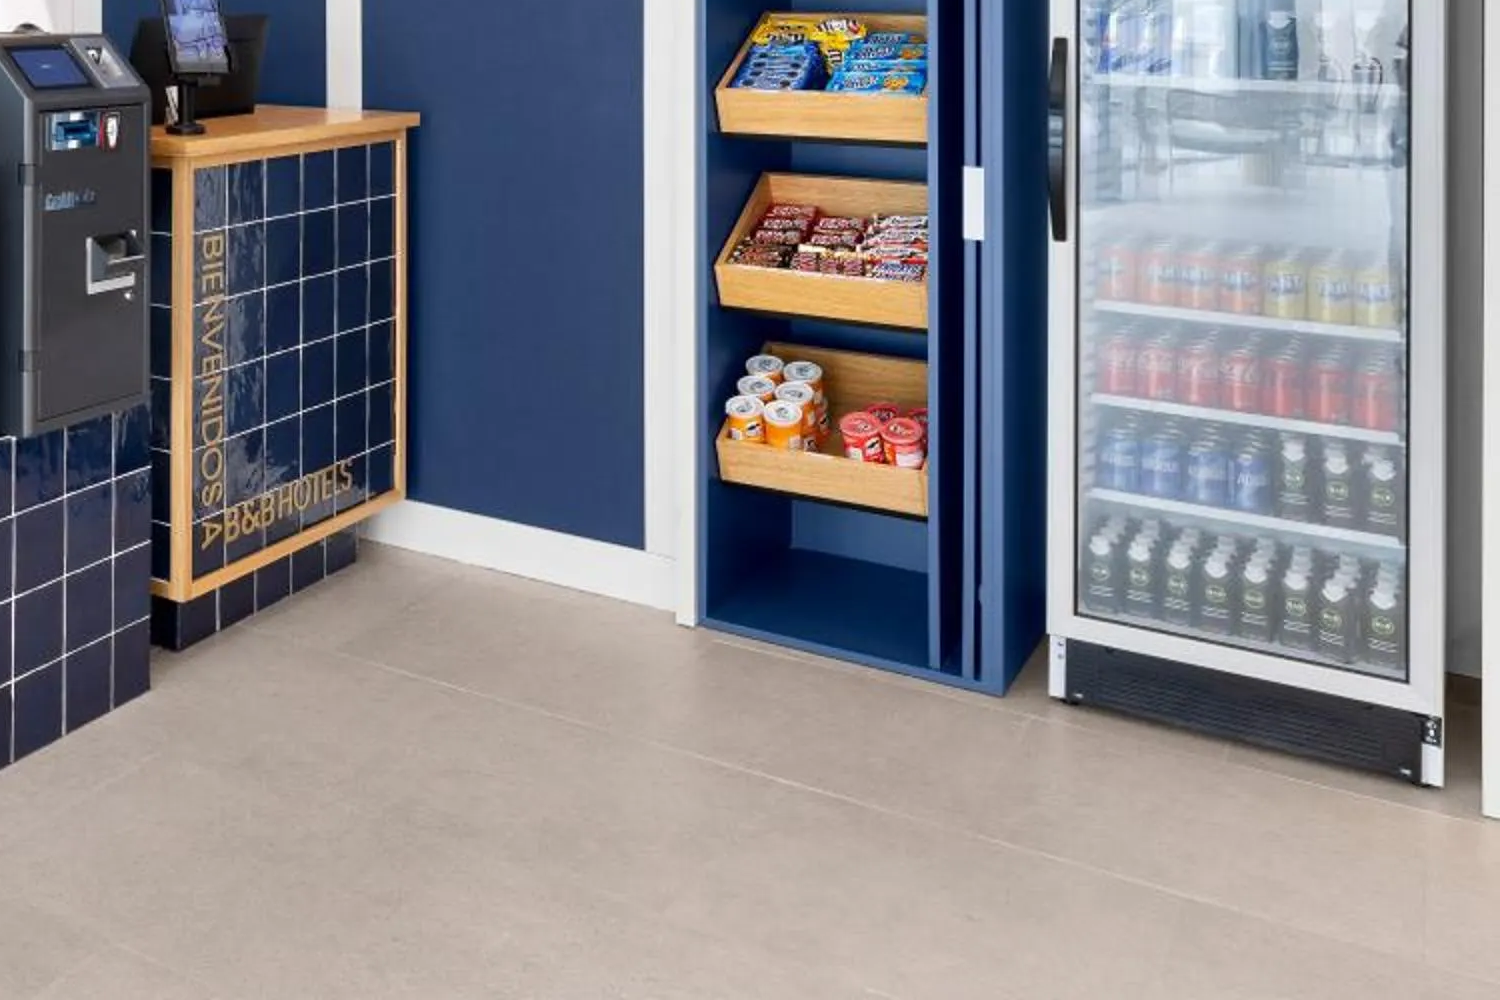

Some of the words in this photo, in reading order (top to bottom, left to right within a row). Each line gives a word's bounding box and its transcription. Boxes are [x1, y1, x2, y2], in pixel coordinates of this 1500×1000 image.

[200, 232, 224, 507] BIENVENIDOS
[201, 522, 224, 550] A
[224, 493, 275, 543] B&B
[278, 459, 354, 520] HOTELS
